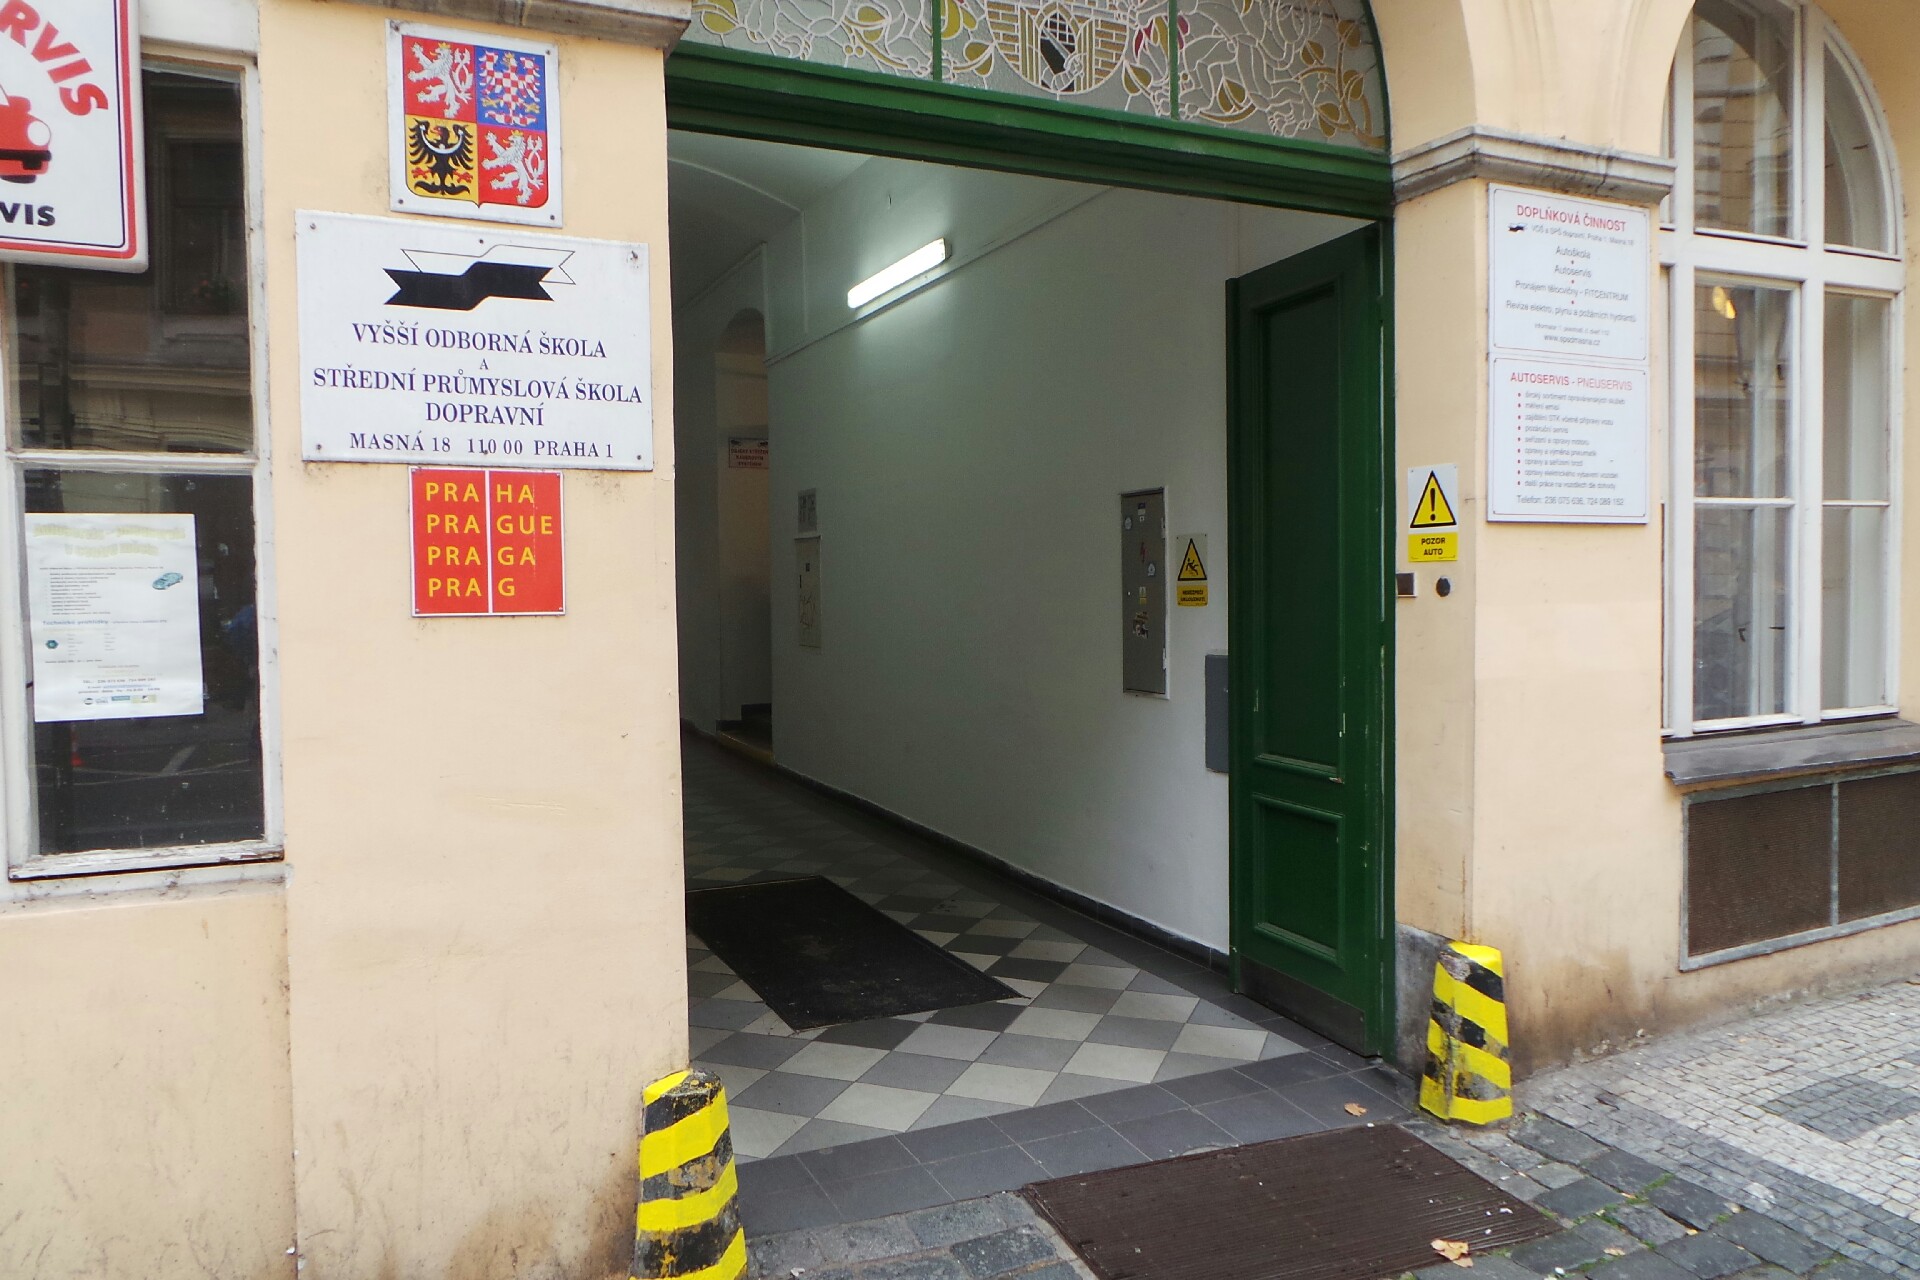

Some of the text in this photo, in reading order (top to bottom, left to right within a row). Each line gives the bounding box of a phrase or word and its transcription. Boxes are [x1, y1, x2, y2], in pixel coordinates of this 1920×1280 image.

[1517, 204, 1627, 232] DOPLŇKOVÁ ČINNOST
[1555, 246, 1591, 259] Autoškola
[1554, 265, 1592, 278] Autoservis
[1515, 279, 1546, 293] Pronájem
[1584, 289, 1629, 301] FITCENTRUM
[352, 320, 607, 358] VYŠŠÍ ODBORNÁ ŠKOLA
[479, 358, 489, 370] A
[313, 364, 642, 404] STŘEDNÍ PRŮMYSLOVÁ ŠKOLA
[1510, 372, 1569, 386] AUTOSERVIS
[1577, 377, 1633, 391] PNEUSERVIS
[426, 402, 544, 426] DOPRAVNÍ
[350, 431, 613, 458] MASNÁ 18 110 00 PRAHA 1
[425, 482, 534, 504] PRA HA
[426, 513, 553, 535] PRA GUE
[1421, 537, 1446, 545] POZOR
[427, 545, 536, 566] PRA GA
[1423, 548, 1443, 556] AUTO
[428, 577, 516, 598] PRA G
